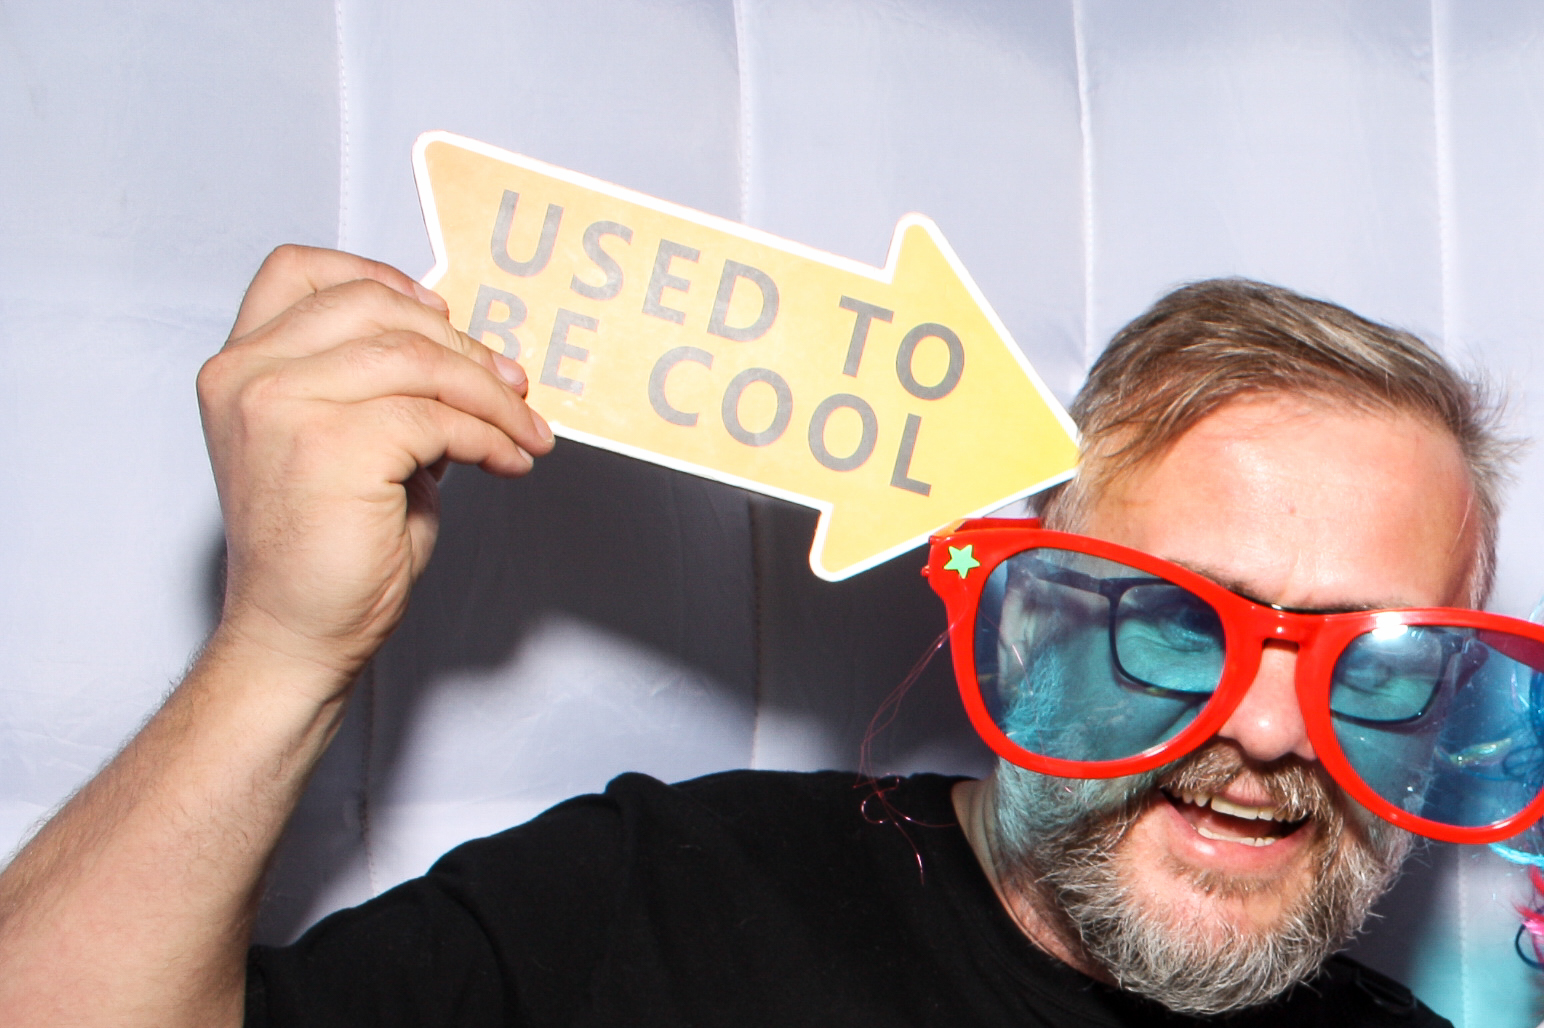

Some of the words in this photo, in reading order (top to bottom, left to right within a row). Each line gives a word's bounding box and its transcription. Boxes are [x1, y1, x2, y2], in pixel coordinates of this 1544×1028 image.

[465, 283, 600, 396] BE
[646, 345, 932, 497] COOL
[489, 189, 780, 342] USED
[838, 295, 965, 400] TO
